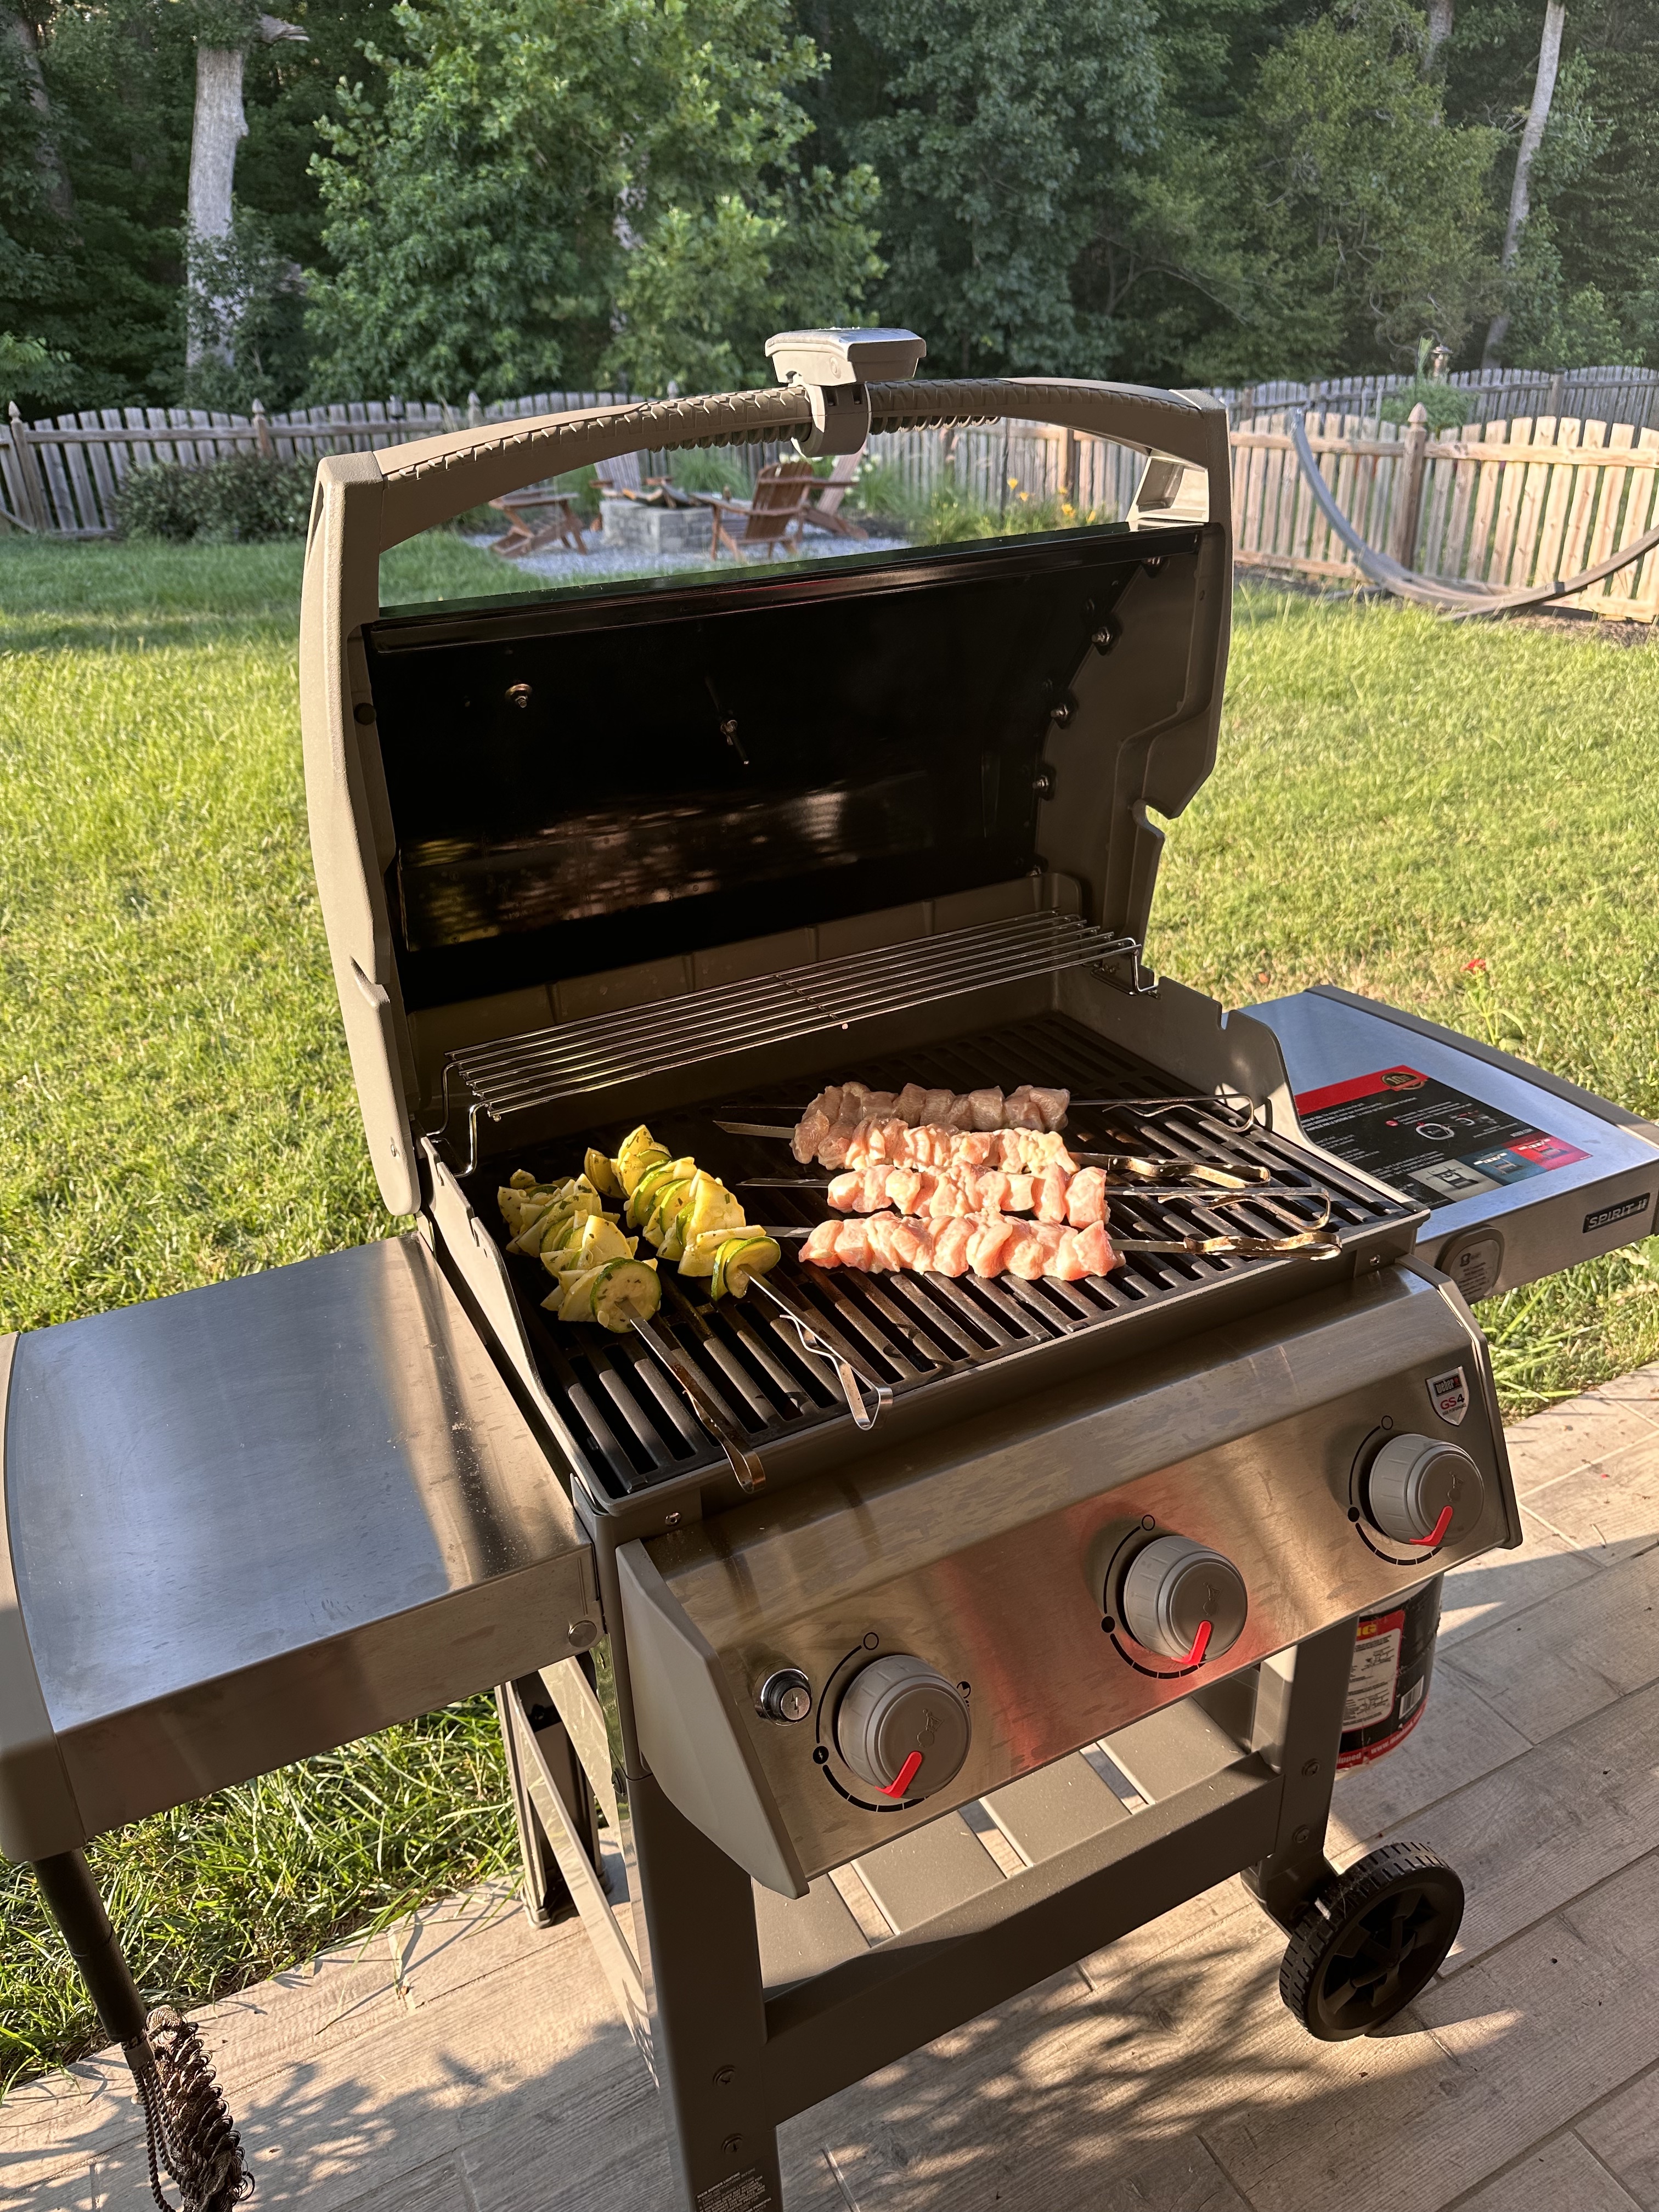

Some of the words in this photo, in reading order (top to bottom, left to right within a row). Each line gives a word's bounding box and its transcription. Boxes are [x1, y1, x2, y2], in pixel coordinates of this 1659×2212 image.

[1588, 1203, 1634, 1229] SPIRIT
[1436, 1379, 1454, 1393] weber
[1440, 1393, 1465, 1409] GS4
